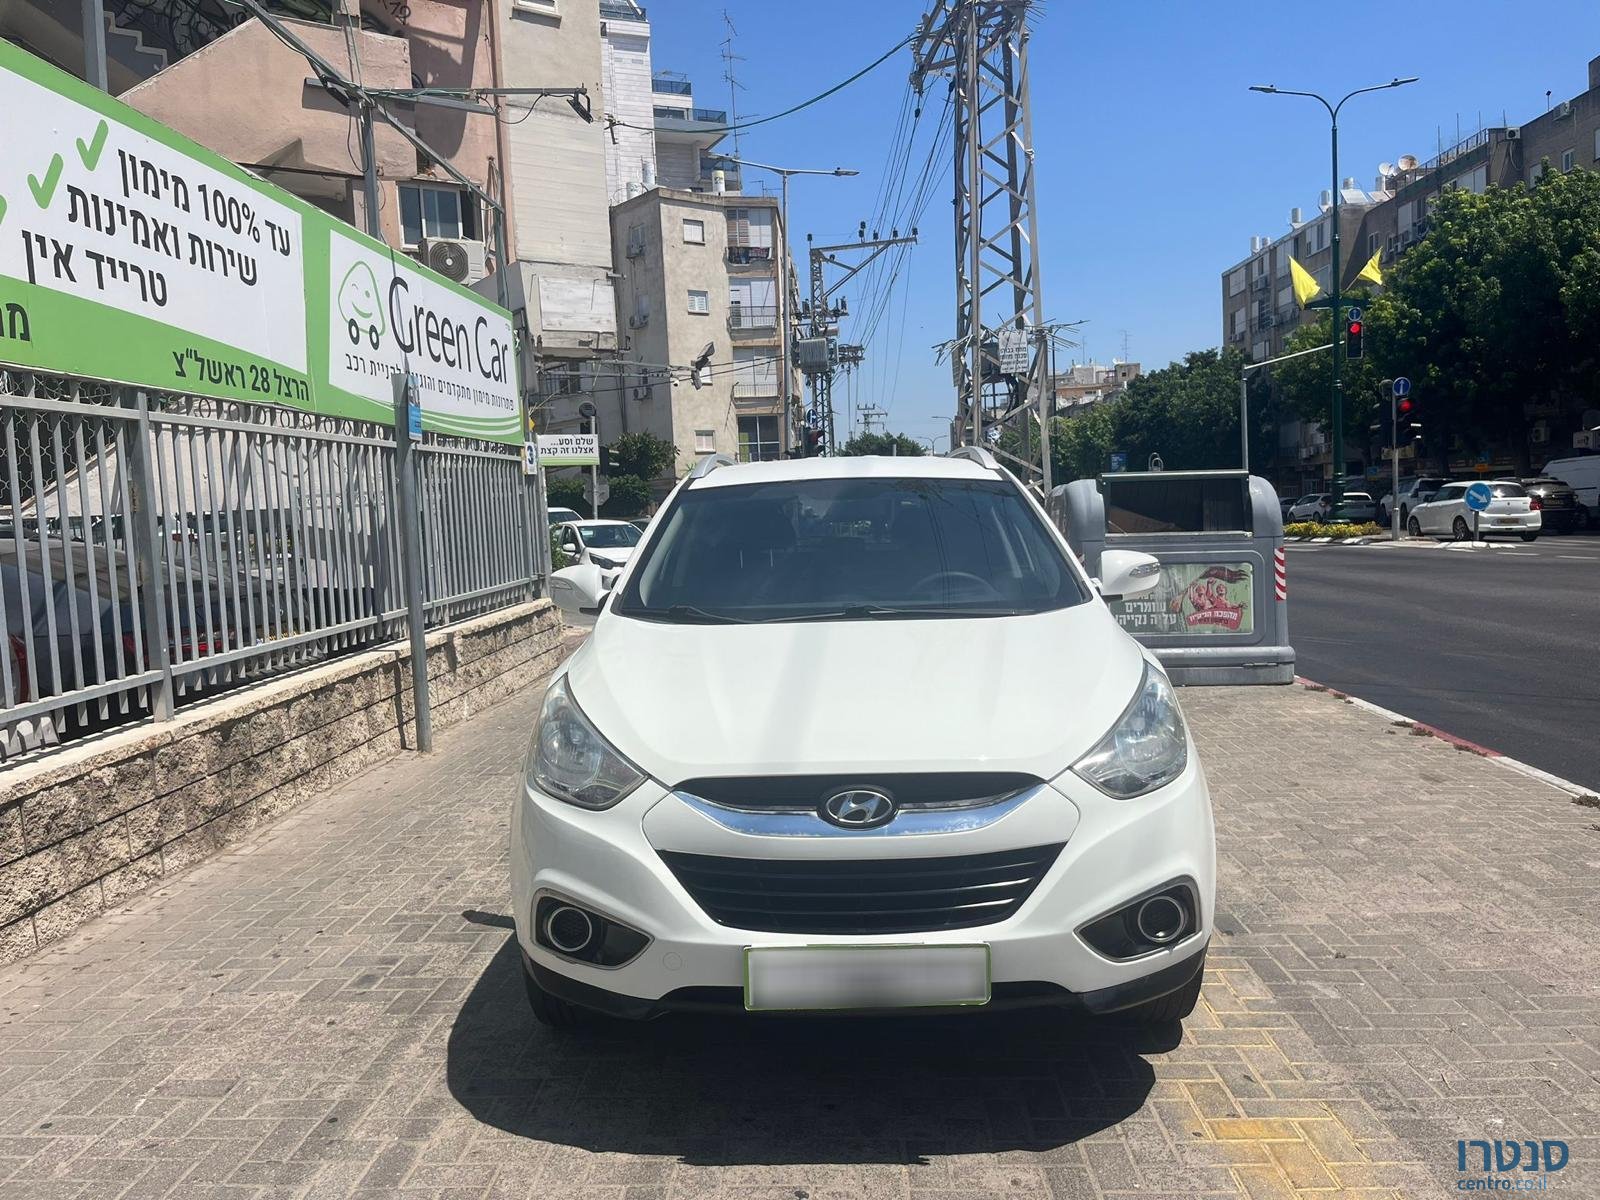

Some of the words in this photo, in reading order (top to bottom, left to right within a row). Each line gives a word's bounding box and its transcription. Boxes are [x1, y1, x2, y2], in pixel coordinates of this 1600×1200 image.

[117, 148, 191, 213] מימון
[66, 183, 182, 260] ואמינות
[197, 183, 261, 244] 100%
[264, 219, 291, 257] עד
[21, 229, 77, 285] אין
[187, 232, 258, 287] שירות
[85, 249, 168, 307] טרייד
[388, 276, 471, 372] Green
[474, 315, 508, 385] Car
[249, 364, 271, 393] 28
[345, 353, 366, 374] רכב
[273, 367, 310, 402] הרצל
[437, 379, 471, 401] מתקדמים
[472, 387, 490, 406] מימון
[526, 445, 534, 465] 3
[540, 447, 558, 456] קצת
[560, 446, 570, 454] זה
[571, 446, 594, 455] אצלנו
[575, 437, 594, 446] שלם
